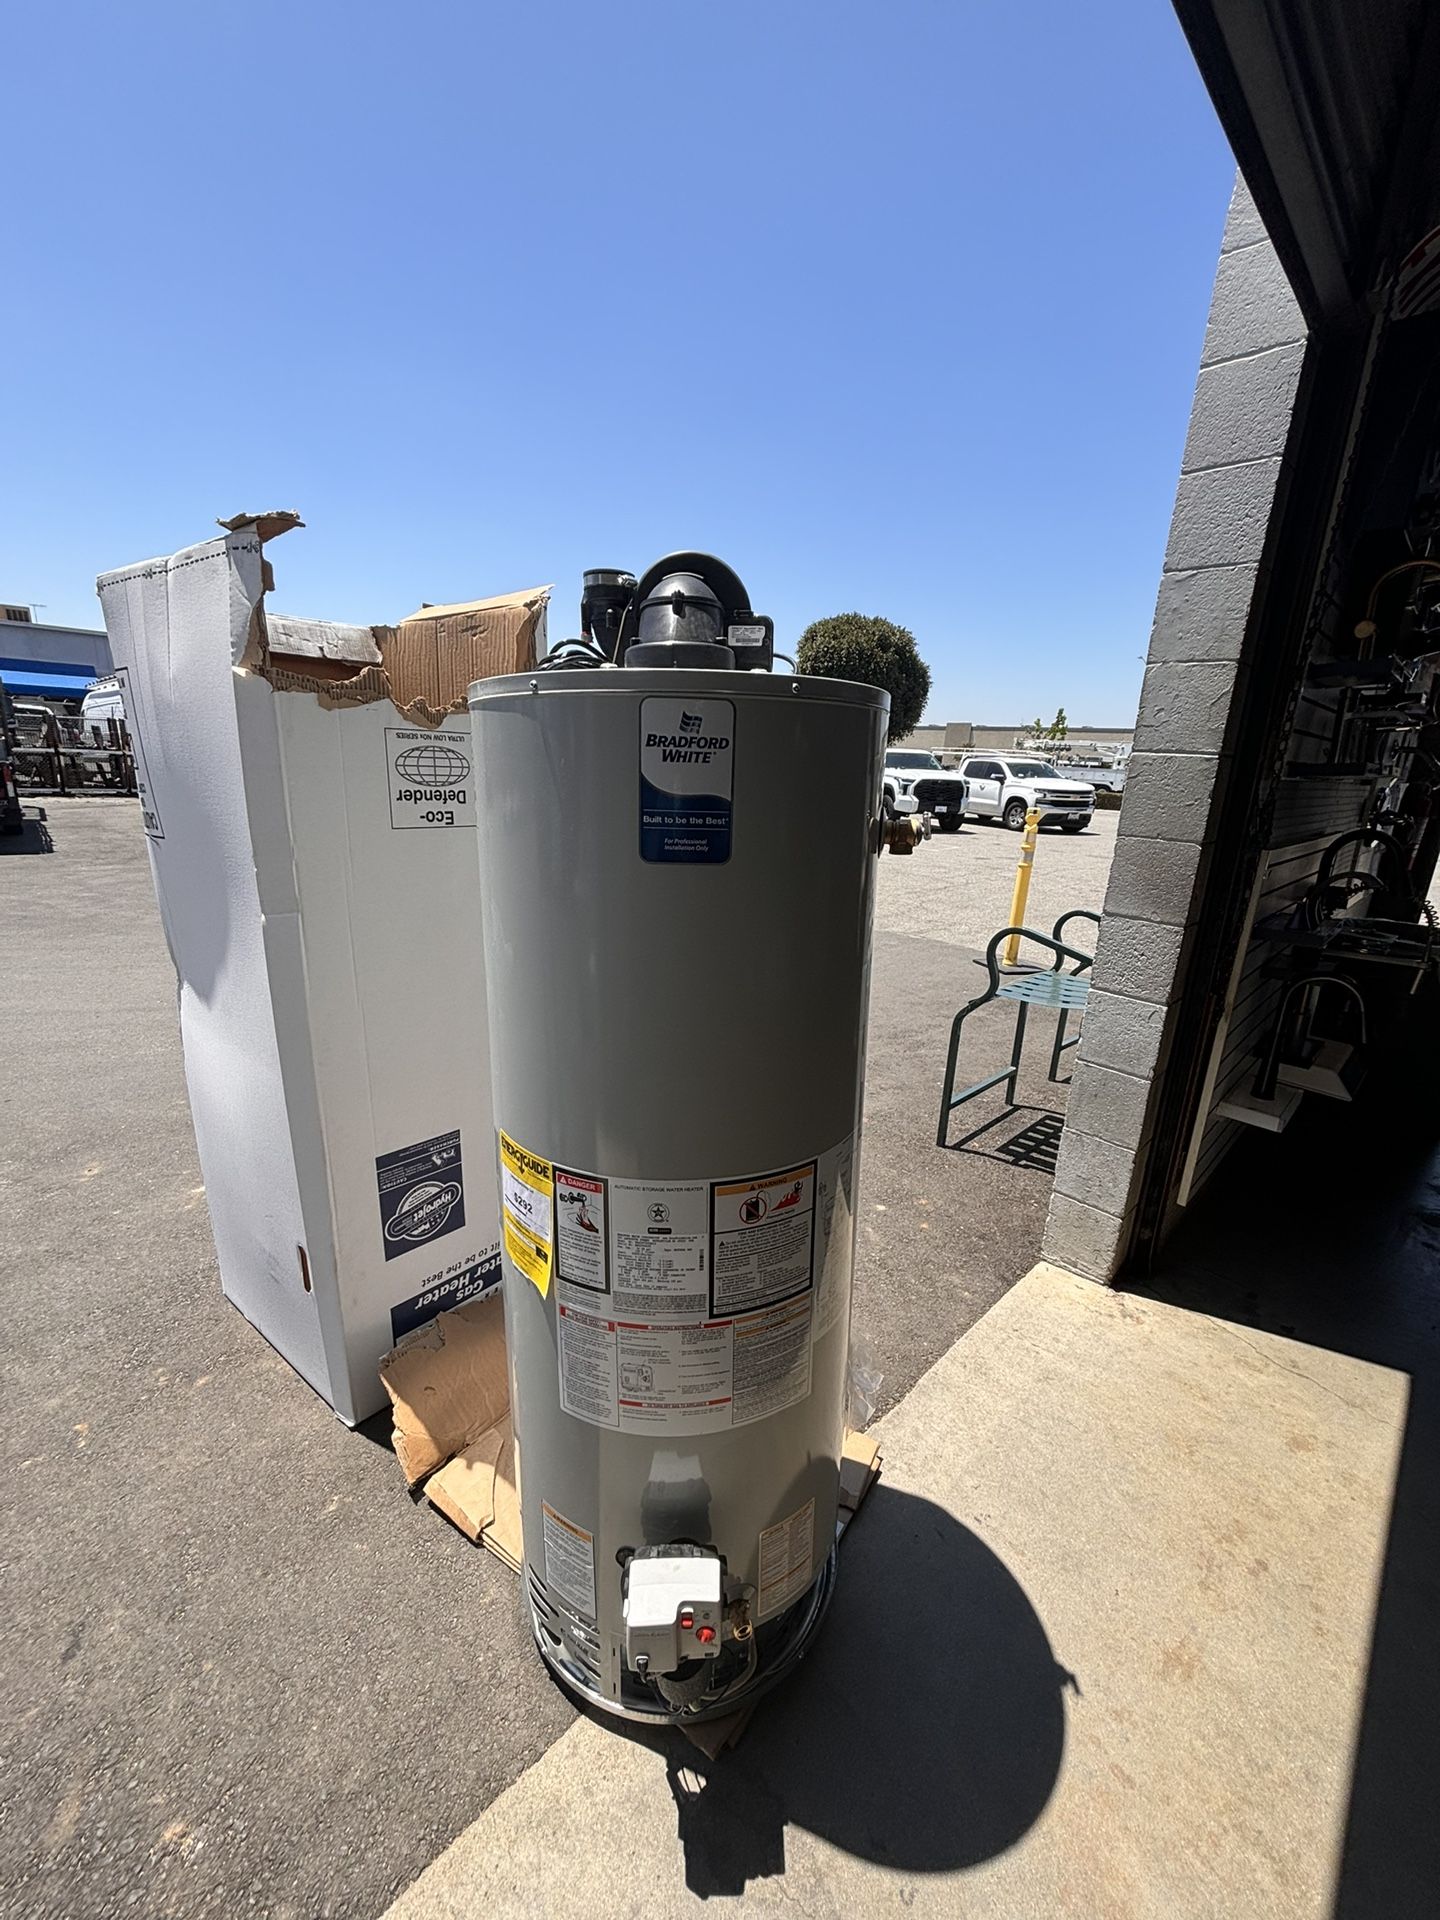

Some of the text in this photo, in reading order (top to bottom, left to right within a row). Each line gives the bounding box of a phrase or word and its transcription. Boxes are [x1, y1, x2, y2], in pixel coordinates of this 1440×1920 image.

[645, 733, 730, 750] BRADFORD
[396, 789, 467, 804] Defender
[420, 810, 454, 825] Eco-
[643, 815, 662, 824] Built
[664, 816, 674, 824] to
[675, 815, 687, 825] be
[689, 816, 703, 825] the
[567, 1179, 597, 1191] DANGER
[413, 1191, 451, 1222] Hydrojet
[478, 1246, 489, 1258] to
[446, 1260, 462, 1275] the
[464, 1254, 476, 1266] be
[421, 1269, 443, 1288] Best
[415, 1274, 470, 1310] Heater
[455, 1278, 484, 1301] Gas
